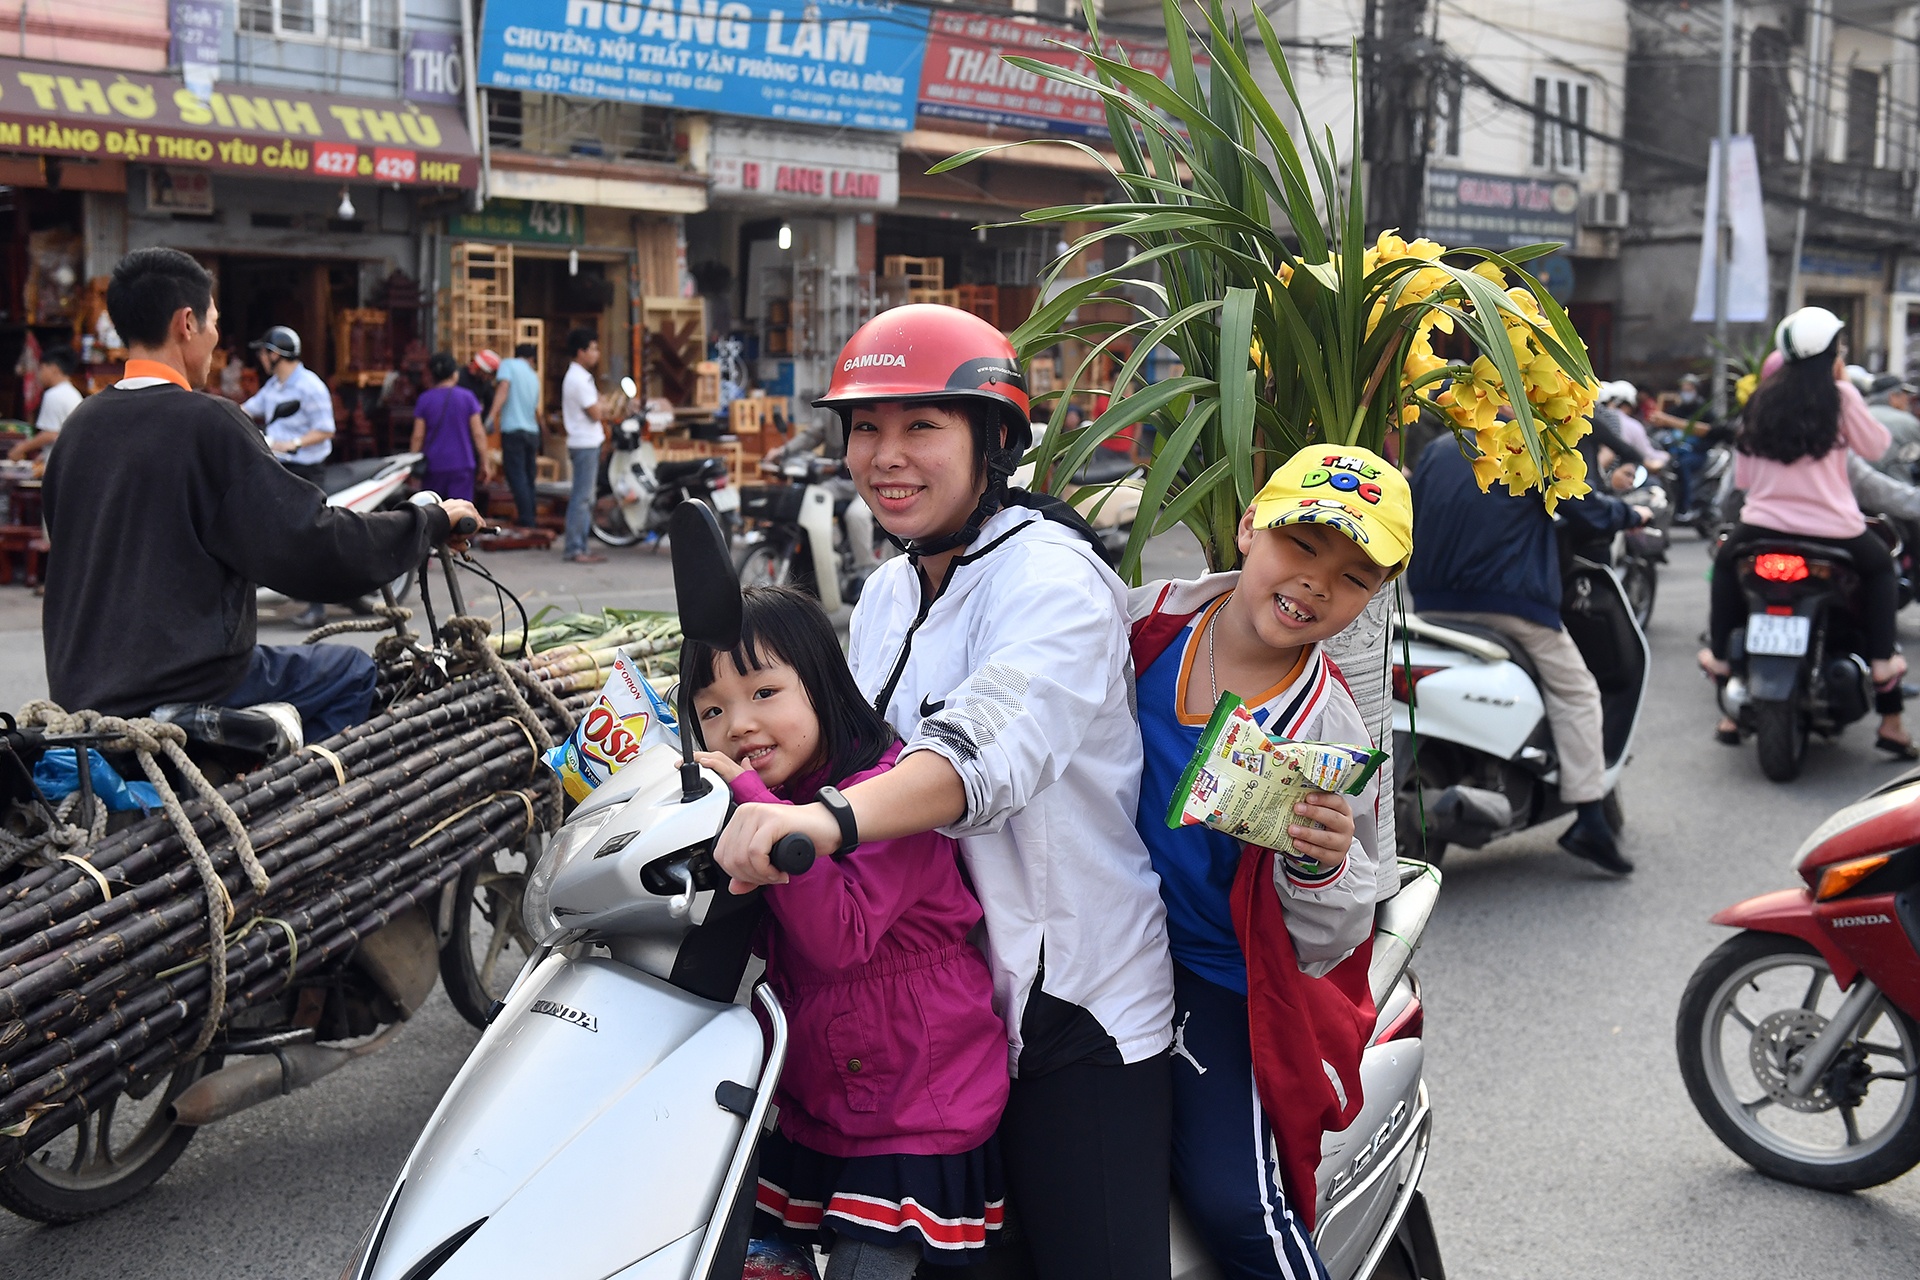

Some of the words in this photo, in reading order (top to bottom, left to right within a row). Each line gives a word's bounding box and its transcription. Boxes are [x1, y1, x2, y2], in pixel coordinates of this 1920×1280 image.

[503, 26, 595, 55] CHUYÊN:
[598, 36, 636, 64] NỘI
[638, 41, 692, 68] THẤT
[694, 49, 736, 75] VĂN
[737, 56, 798, 83] PHÒNG
[801, 63, 827, 87] VÀ
[828, 70, 860, 91] GIA
[862, 70, 905, 96] ĐÌNH
[17, 72, 157, 120] THỜ
[173, 88, 322, 136] SINH
[27, 121, 100, 152] HÀNG
[105, 128, 152, 160] ĐẶT
[156, 136, 214, 161] THEO
[218, 138, 258, 166] YÊU
[262, 138, 309, 171] CẦU
[315, 151, 356, 174] 427
[358, 155, 374, 175] &
[376, 157, 415, 180] 429
[420, 161, 461, 184] HHT
[529, 200, 574, 236] 431
[843, 353, 907, 372] GAMUDA
[1321, 455, 1382, 480] THE
[1301, 469, 1382, 505] DOC
[621, 671, 642, 700] ORION
[584, 707, 641, 764] O'St
[1832, 914, 1892, 928] HONDA
[530, 999, 598, 1033] HONDA
[1326, 1100, 1406, 1201] LEAD
